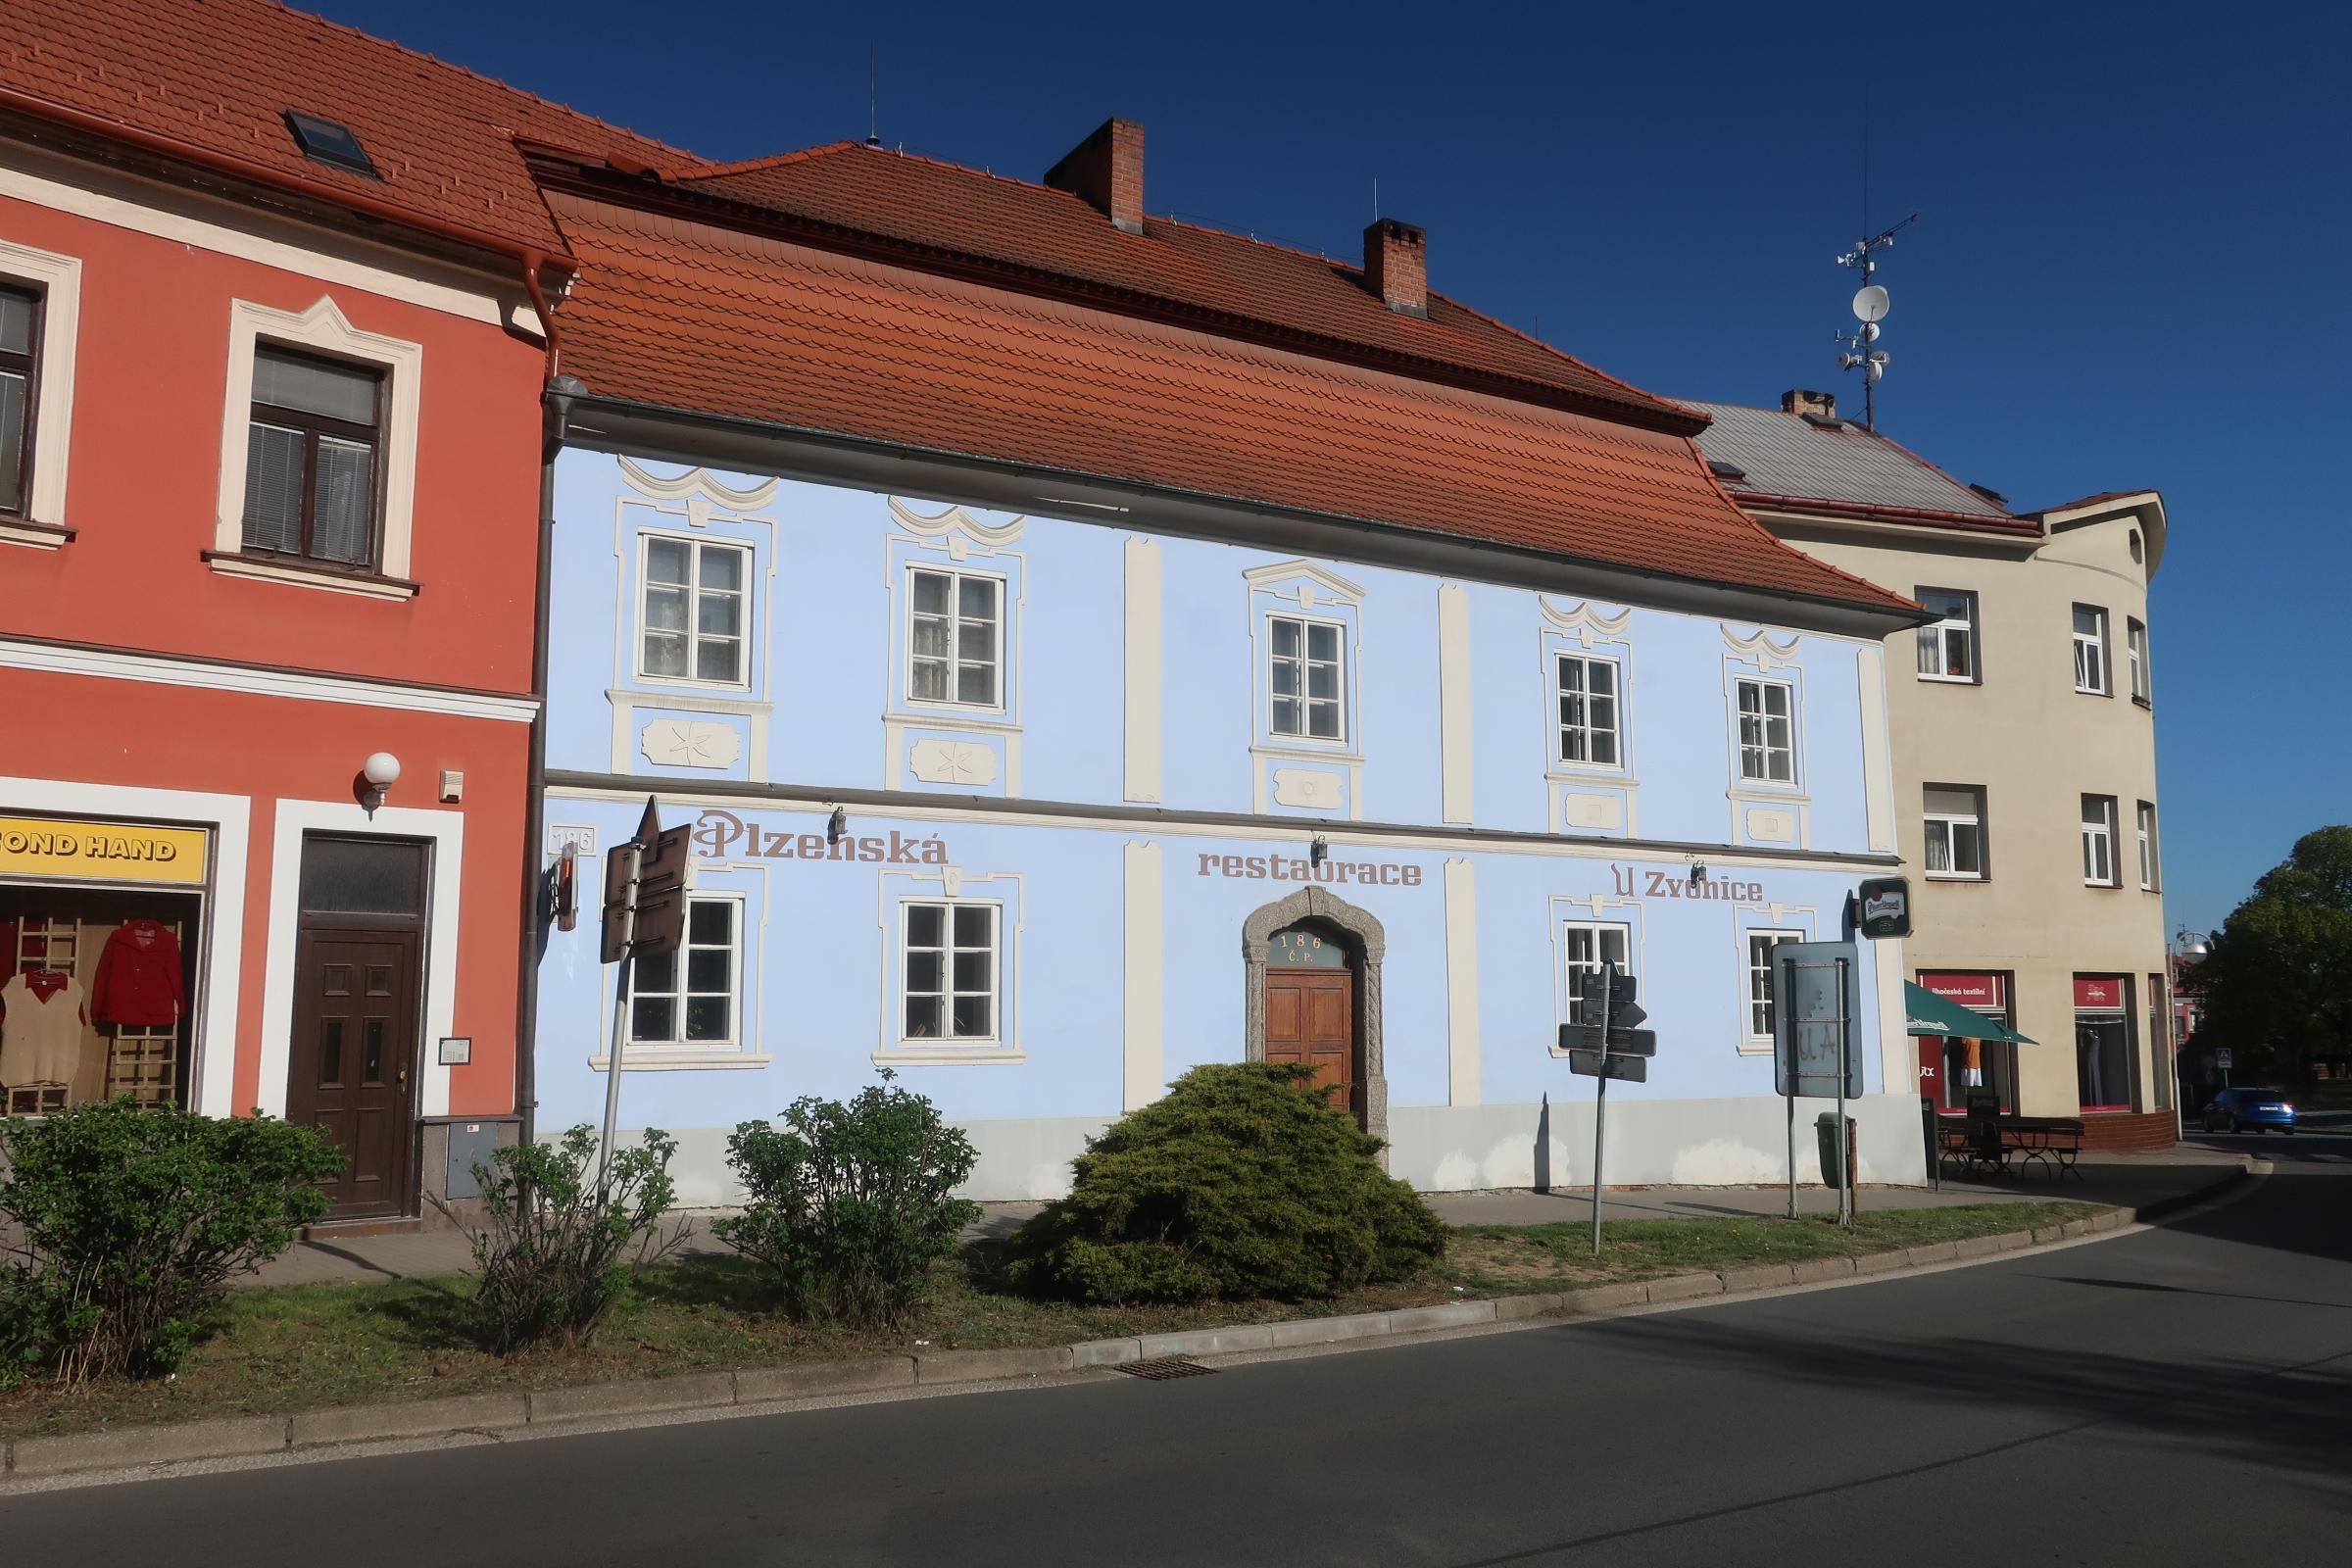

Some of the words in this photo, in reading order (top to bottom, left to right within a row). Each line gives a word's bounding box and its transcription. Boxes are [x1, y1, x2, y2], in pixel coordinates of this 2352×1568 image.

[0, 830, 78, 857] OND
[85, 836, 176, 861] HAND
[1198, 853, 1422, 887] restaurace
[1610, 862, 1635, 897] U
[1644, 870, 1763, 902] Zvonice
[1280, 934, 1321, 949] 186
